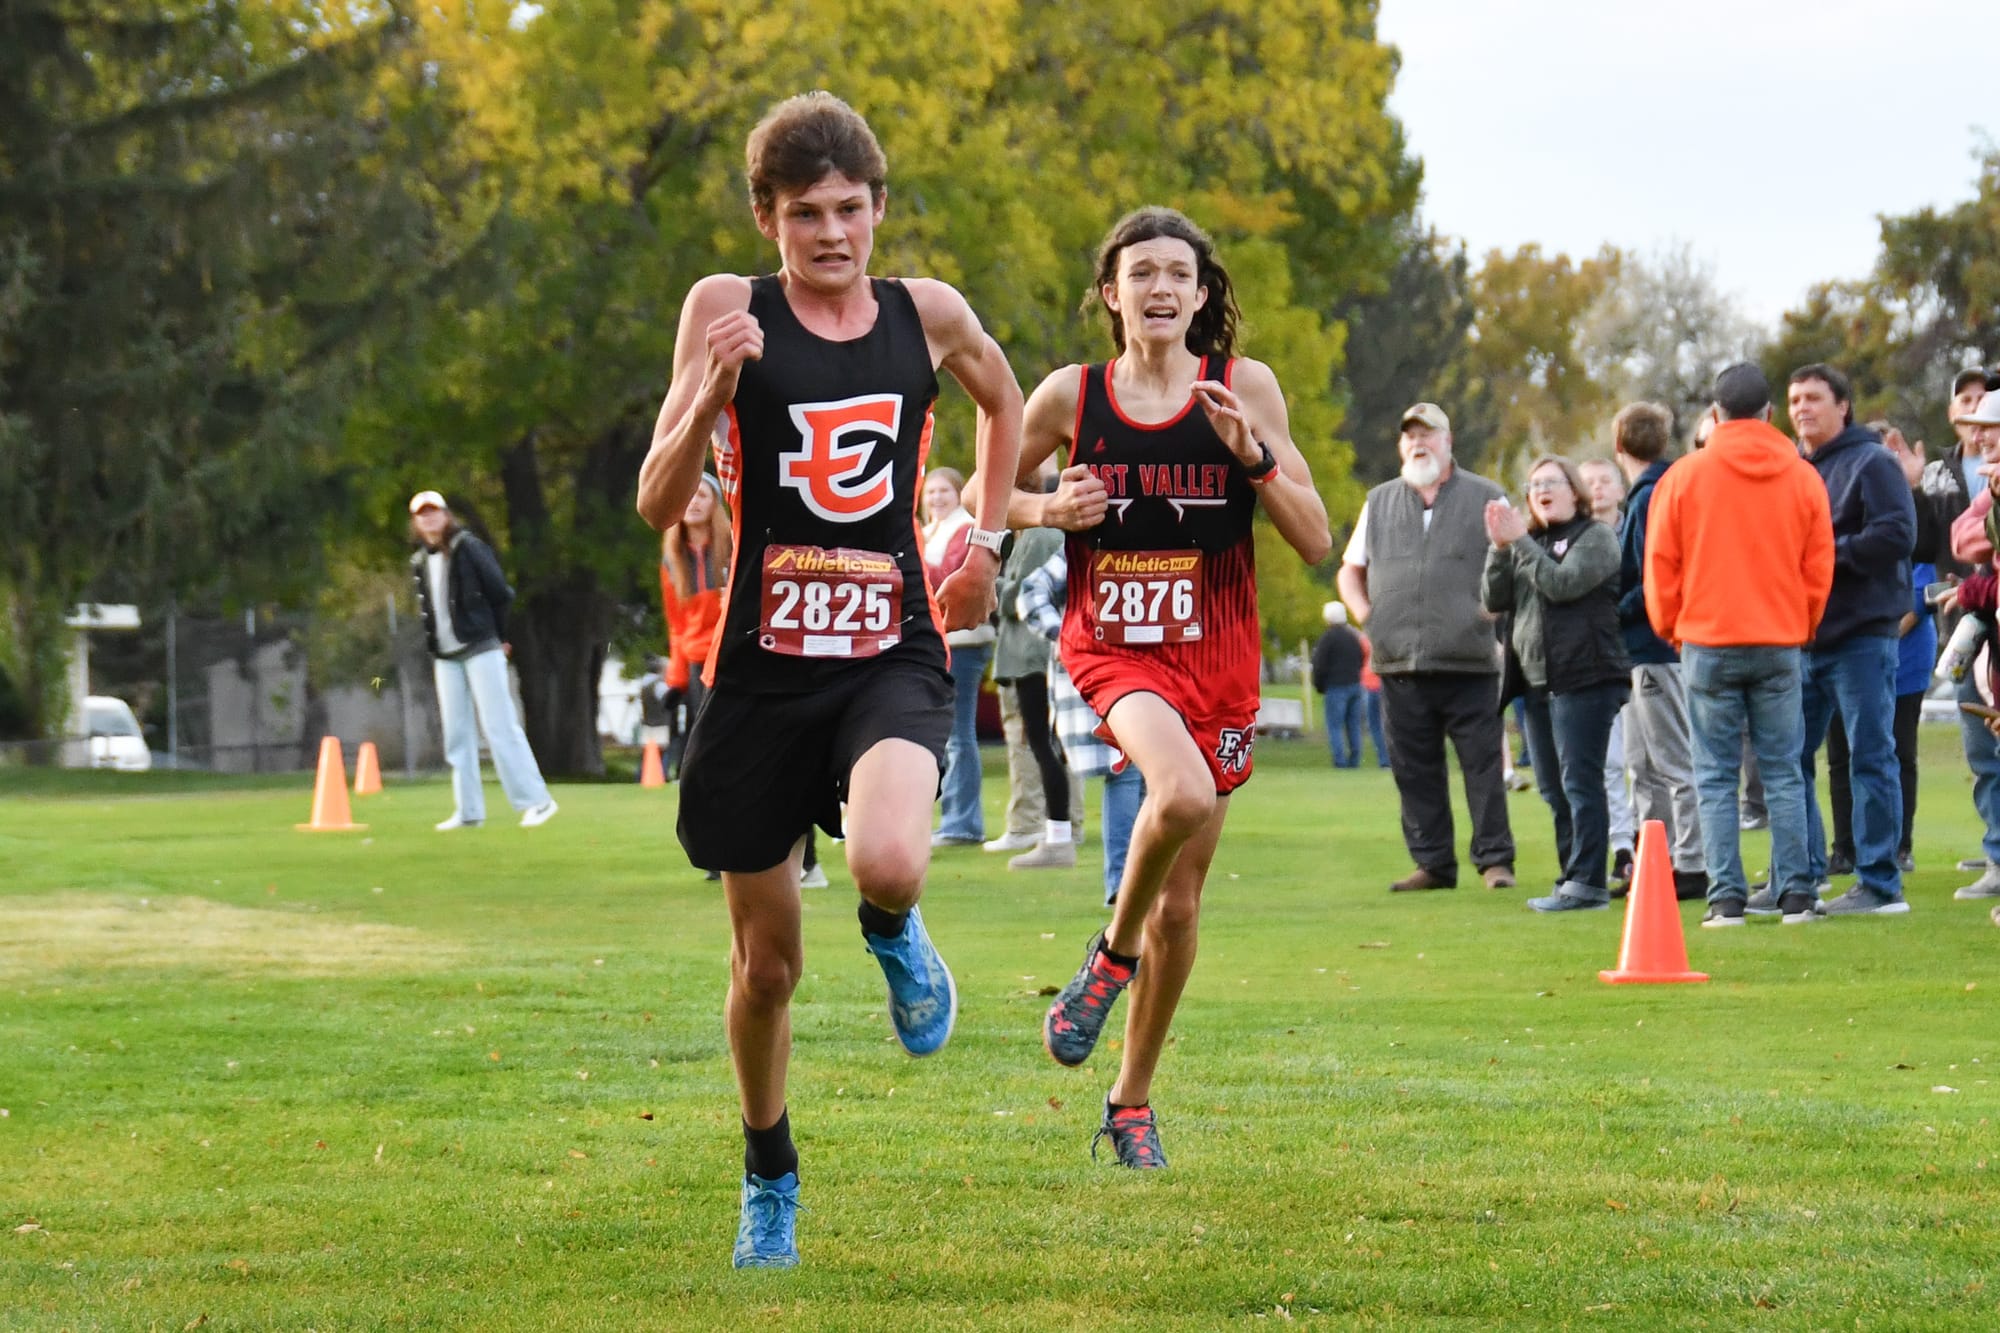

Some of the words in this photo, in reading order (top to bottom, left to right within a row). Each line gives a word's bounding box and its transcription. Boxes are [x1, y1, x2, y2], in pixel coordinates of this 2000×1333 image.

[1089, 464, 1128, 496] ST
[1139, 464, 1229, 496] VALLEY
[768, 549, 862, 571] Athletic
[1096, 553, 1170, 571] Athletic
[770, 580, 893, 631] 2825
[1099, 579, 1193, 623] 2876
